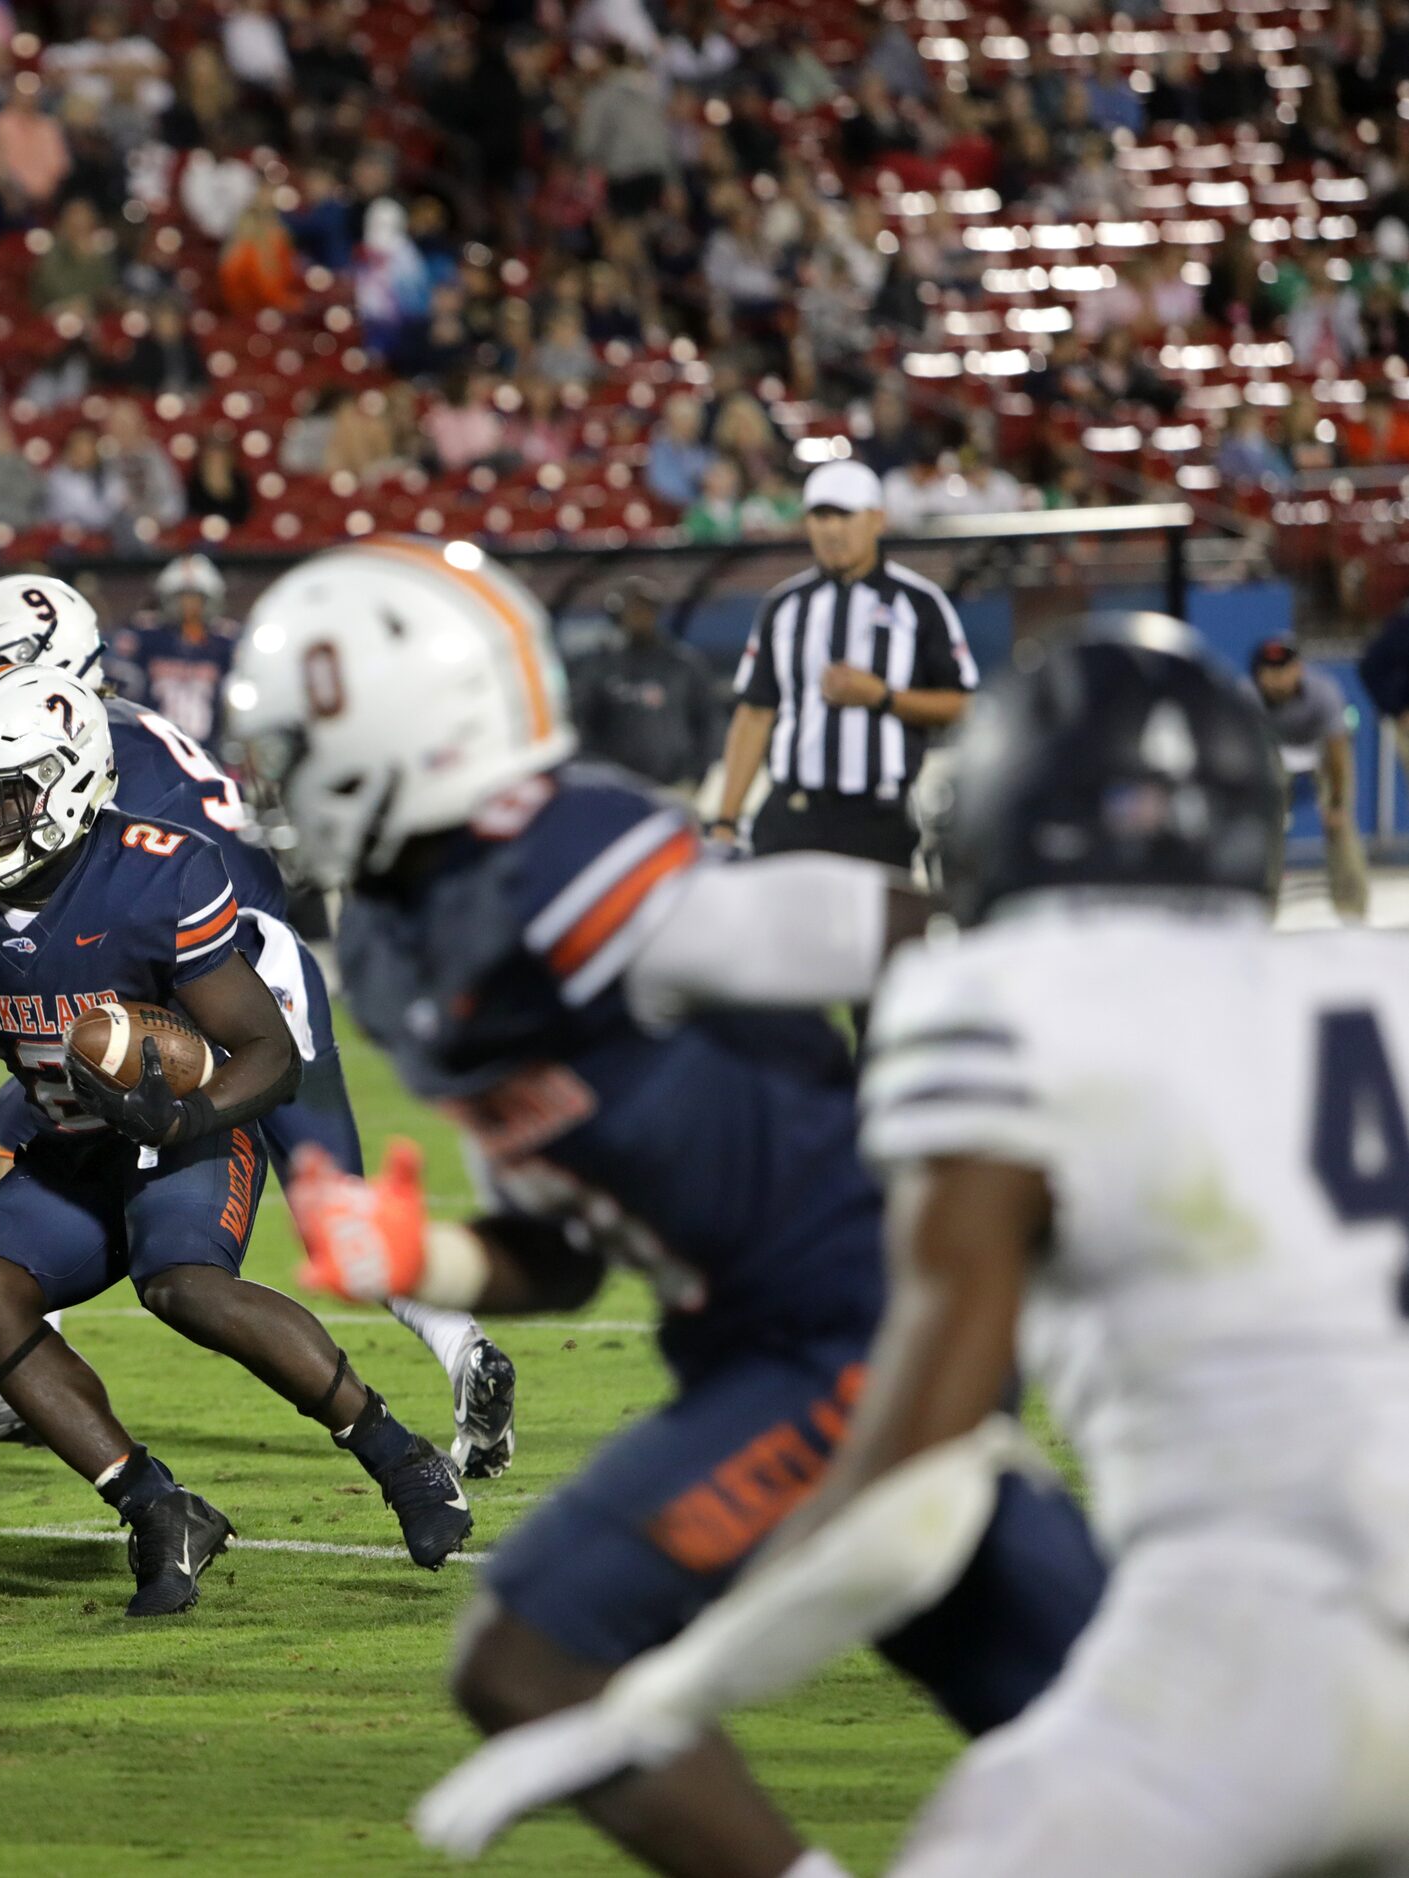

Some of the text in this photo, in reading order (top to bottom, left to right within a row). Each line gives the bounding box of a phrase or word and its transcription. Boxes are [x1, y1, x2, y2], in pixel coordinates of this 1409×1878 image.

[22, 589, 56, 621] 9
[45, 693, 85, 741] 2
[122, 823, 188, 856] 2
